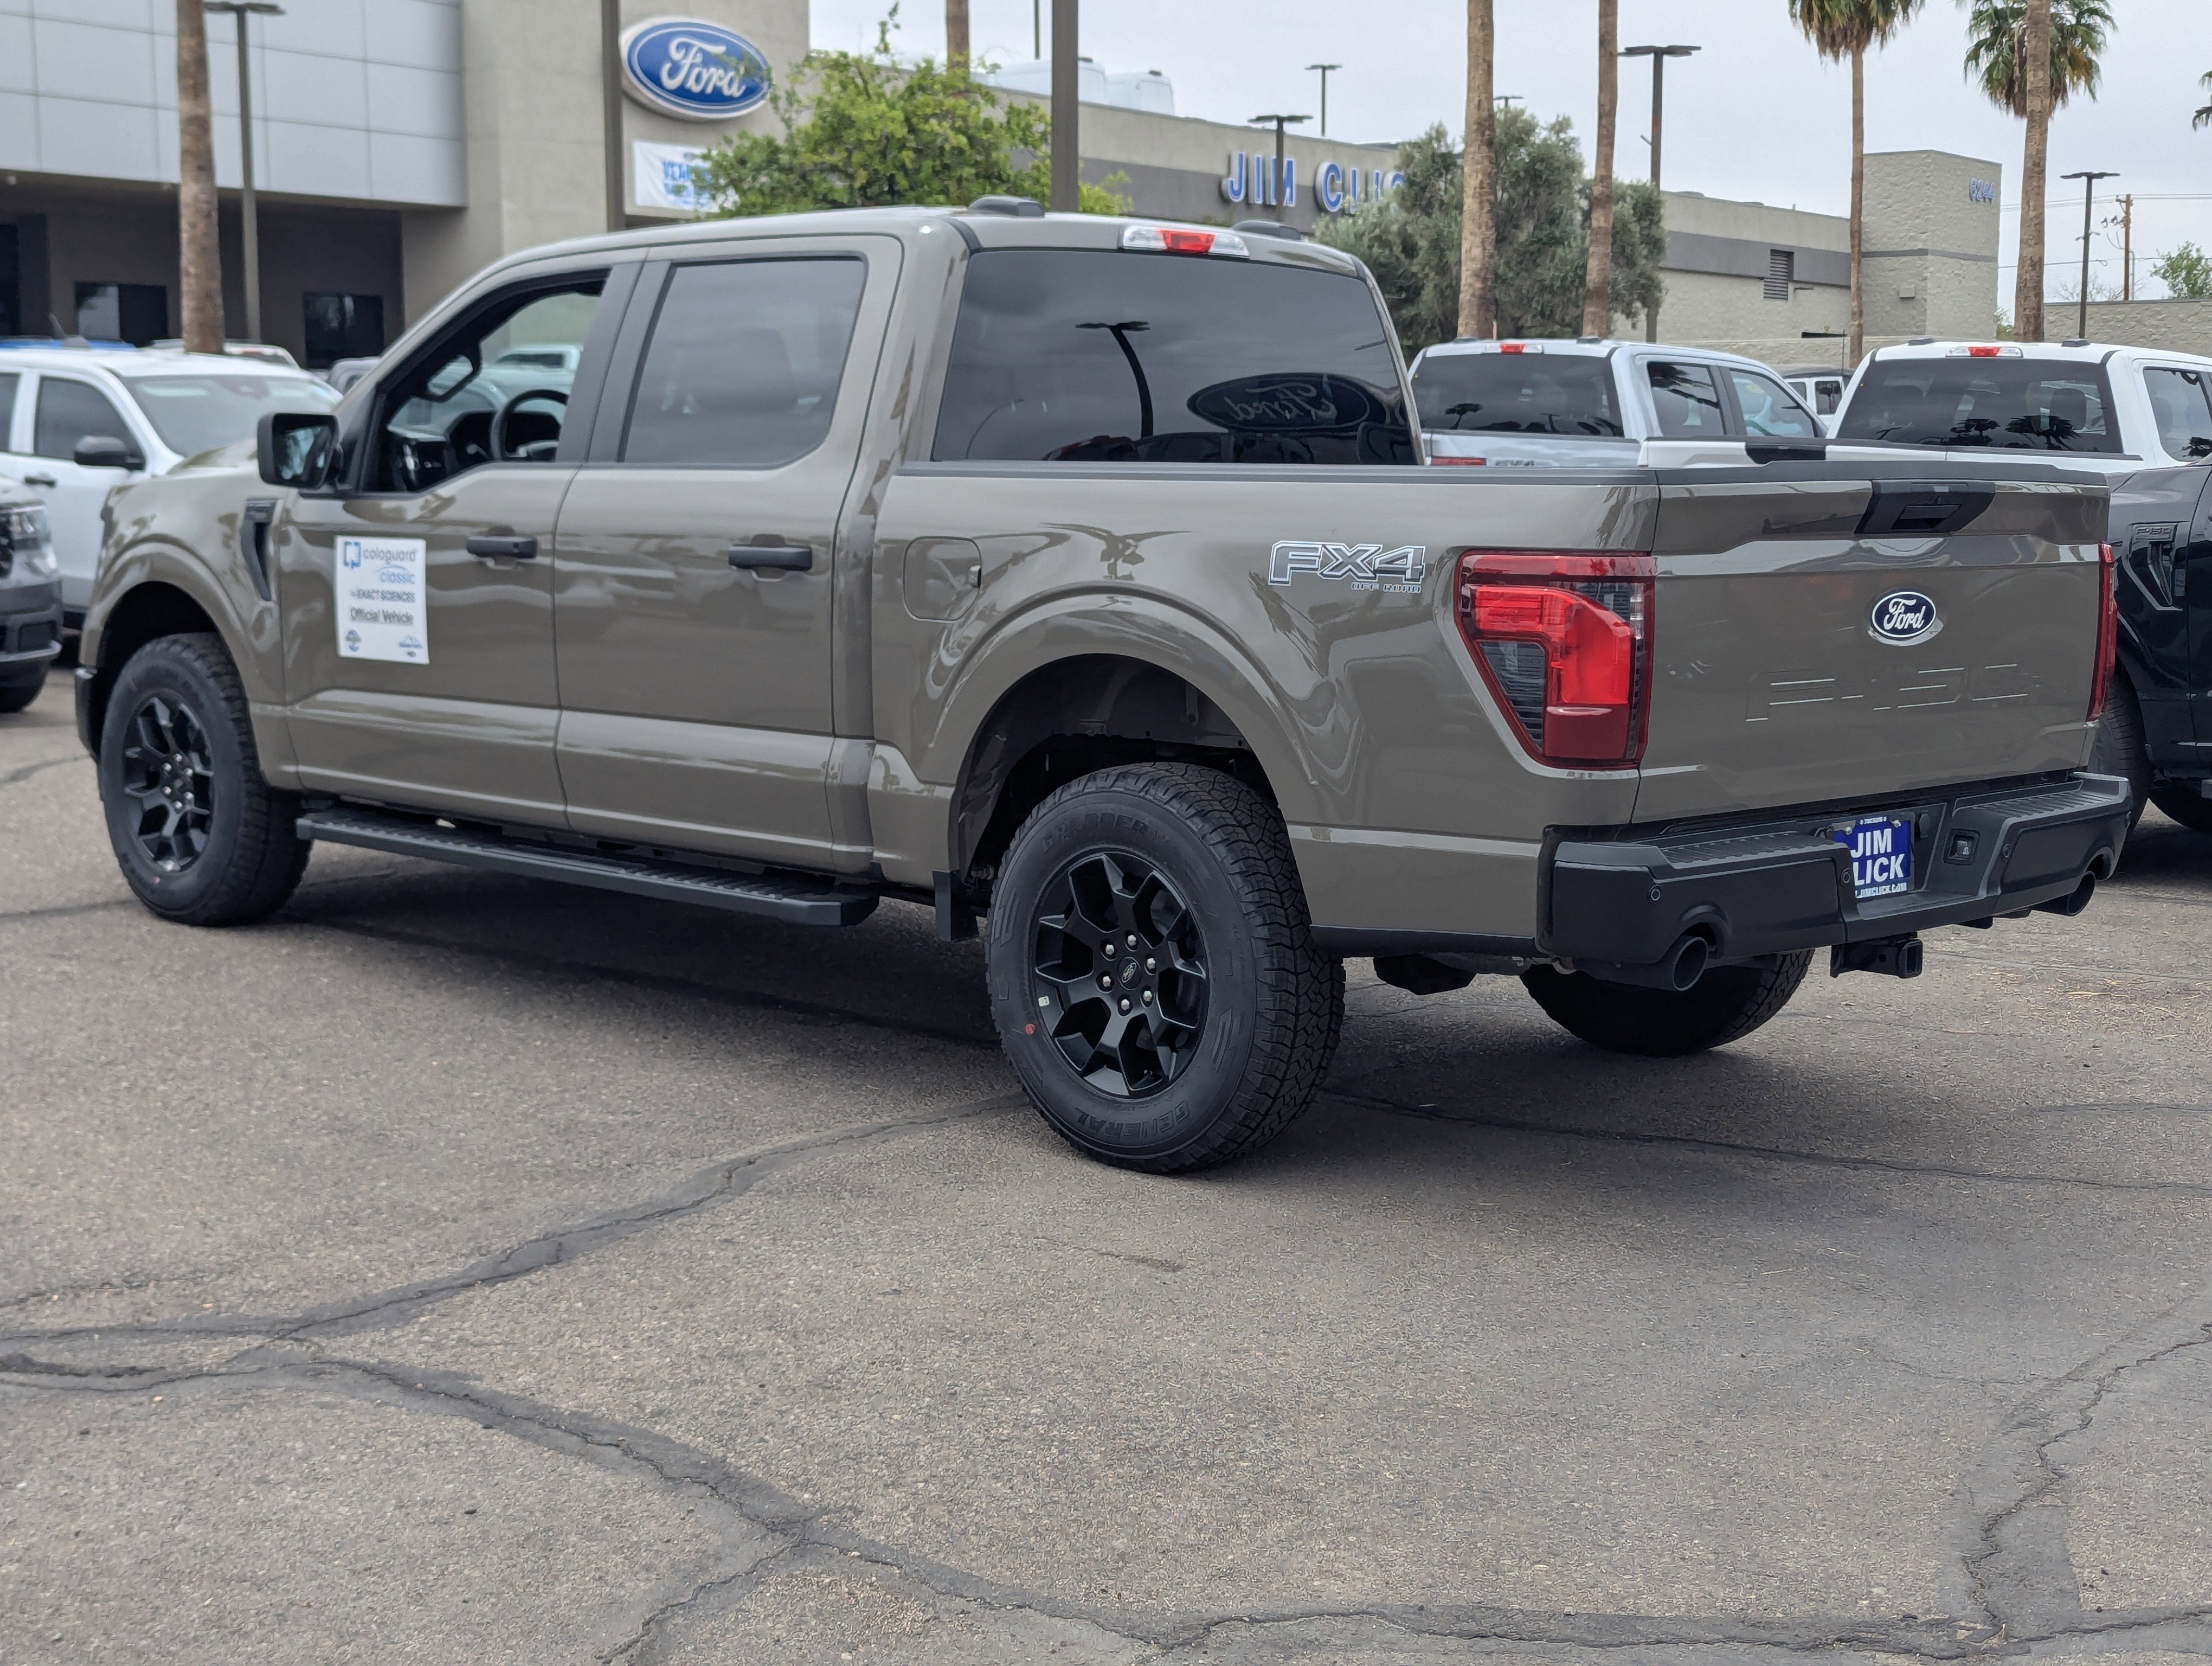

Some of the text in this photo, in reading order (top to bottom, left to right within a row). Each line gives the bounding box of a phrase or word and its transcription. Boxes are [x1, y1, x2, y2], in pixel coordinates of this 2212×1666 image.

[661, 37, 745, 97] Ford
[1221, 151, 1297, 207] JIM
[363, 547, 416, 563] cologuard
[1268, 540, 1426, 586] FX4
[380, 571, 416, 584] classic
[1383, 583, 1422, 593] ROAD
[350, 606, 414, 624] Official Vehicle
[1883, 599, 1926, 630] Ford
[1850, 828, 1892, 858] JIM
[1853, 854, 1905, 886] LICK
